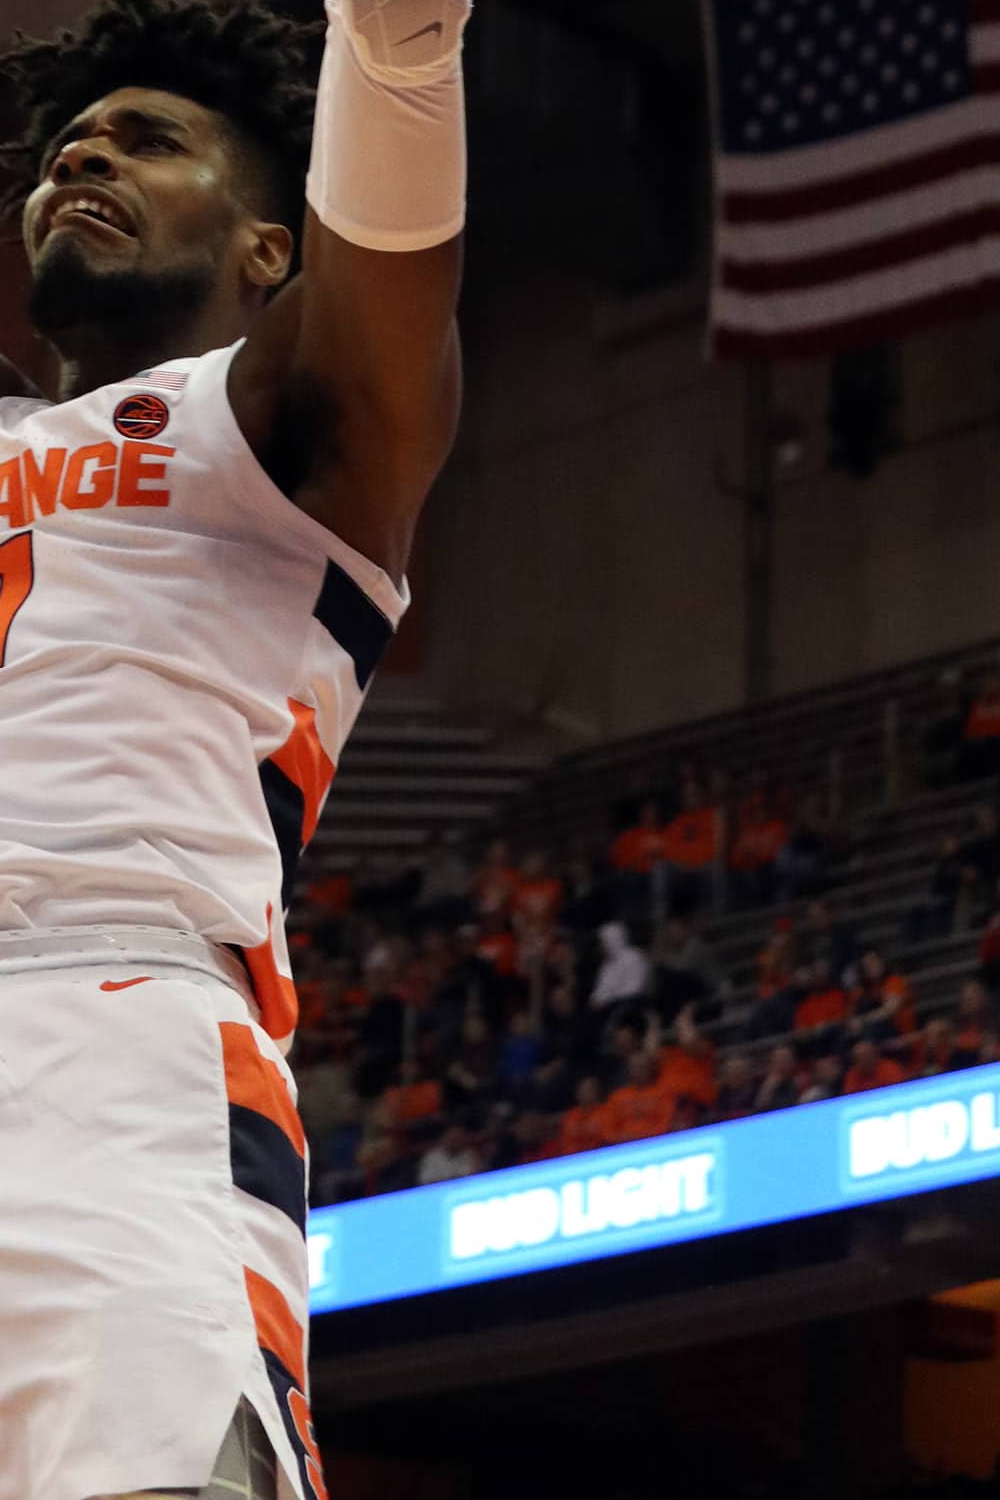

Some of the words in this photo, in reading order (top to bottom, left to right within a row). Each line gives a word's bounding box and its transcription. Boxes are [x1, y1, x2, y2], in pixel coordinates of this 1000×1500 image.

[850, 1099, 969, 1177] BUD
[970, 1092, 1000, 1153] L
[451, 1187, 558, 1259] BUD
[559, 1153, 716, 1236] LIGHT
